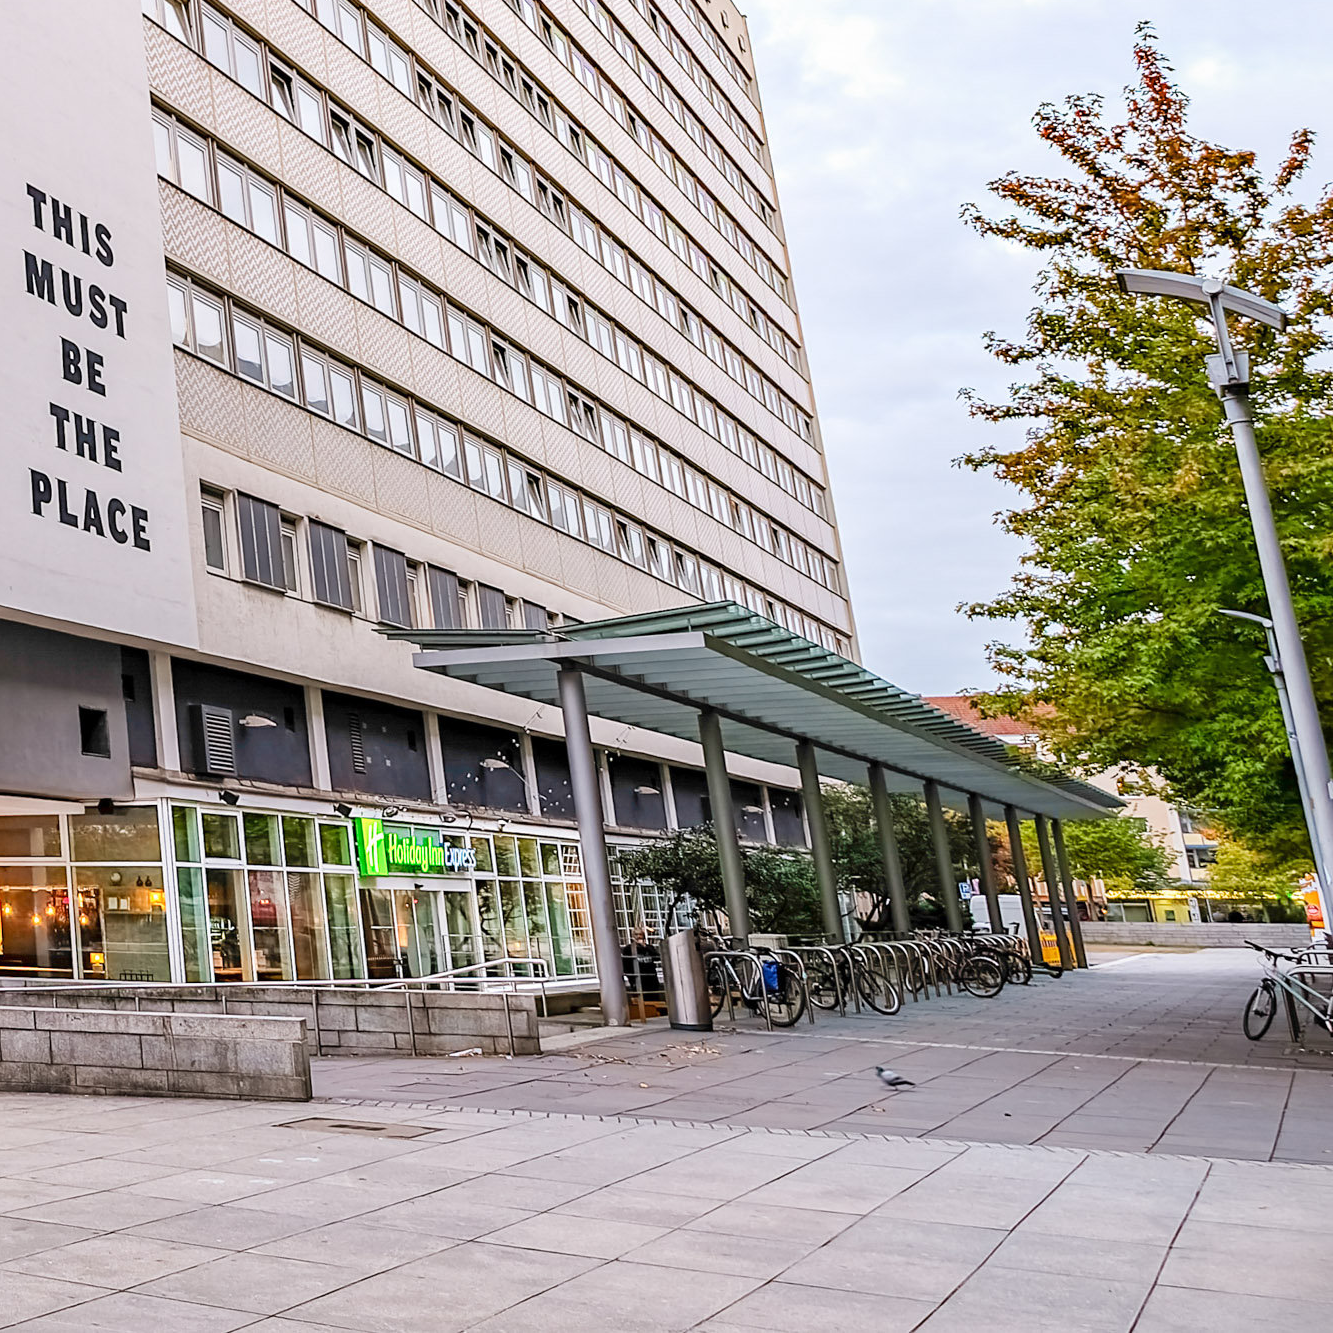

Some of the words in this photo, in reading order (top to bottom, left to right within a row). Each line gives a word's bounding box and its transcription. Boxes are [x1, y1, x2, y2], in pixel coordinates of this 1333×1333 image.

[26, 183, 114, 268] THIS
[23, 249, 128, 339] MUST
[60, 336, 107, 397] BE
[49, 401, 123, 473] THE
[28, 467, 151, 552] PLACE
[388, 833, 428, 872] Holiday
[428, 836, 444, 866] Inn
[444, 841, 477, 872] Express
